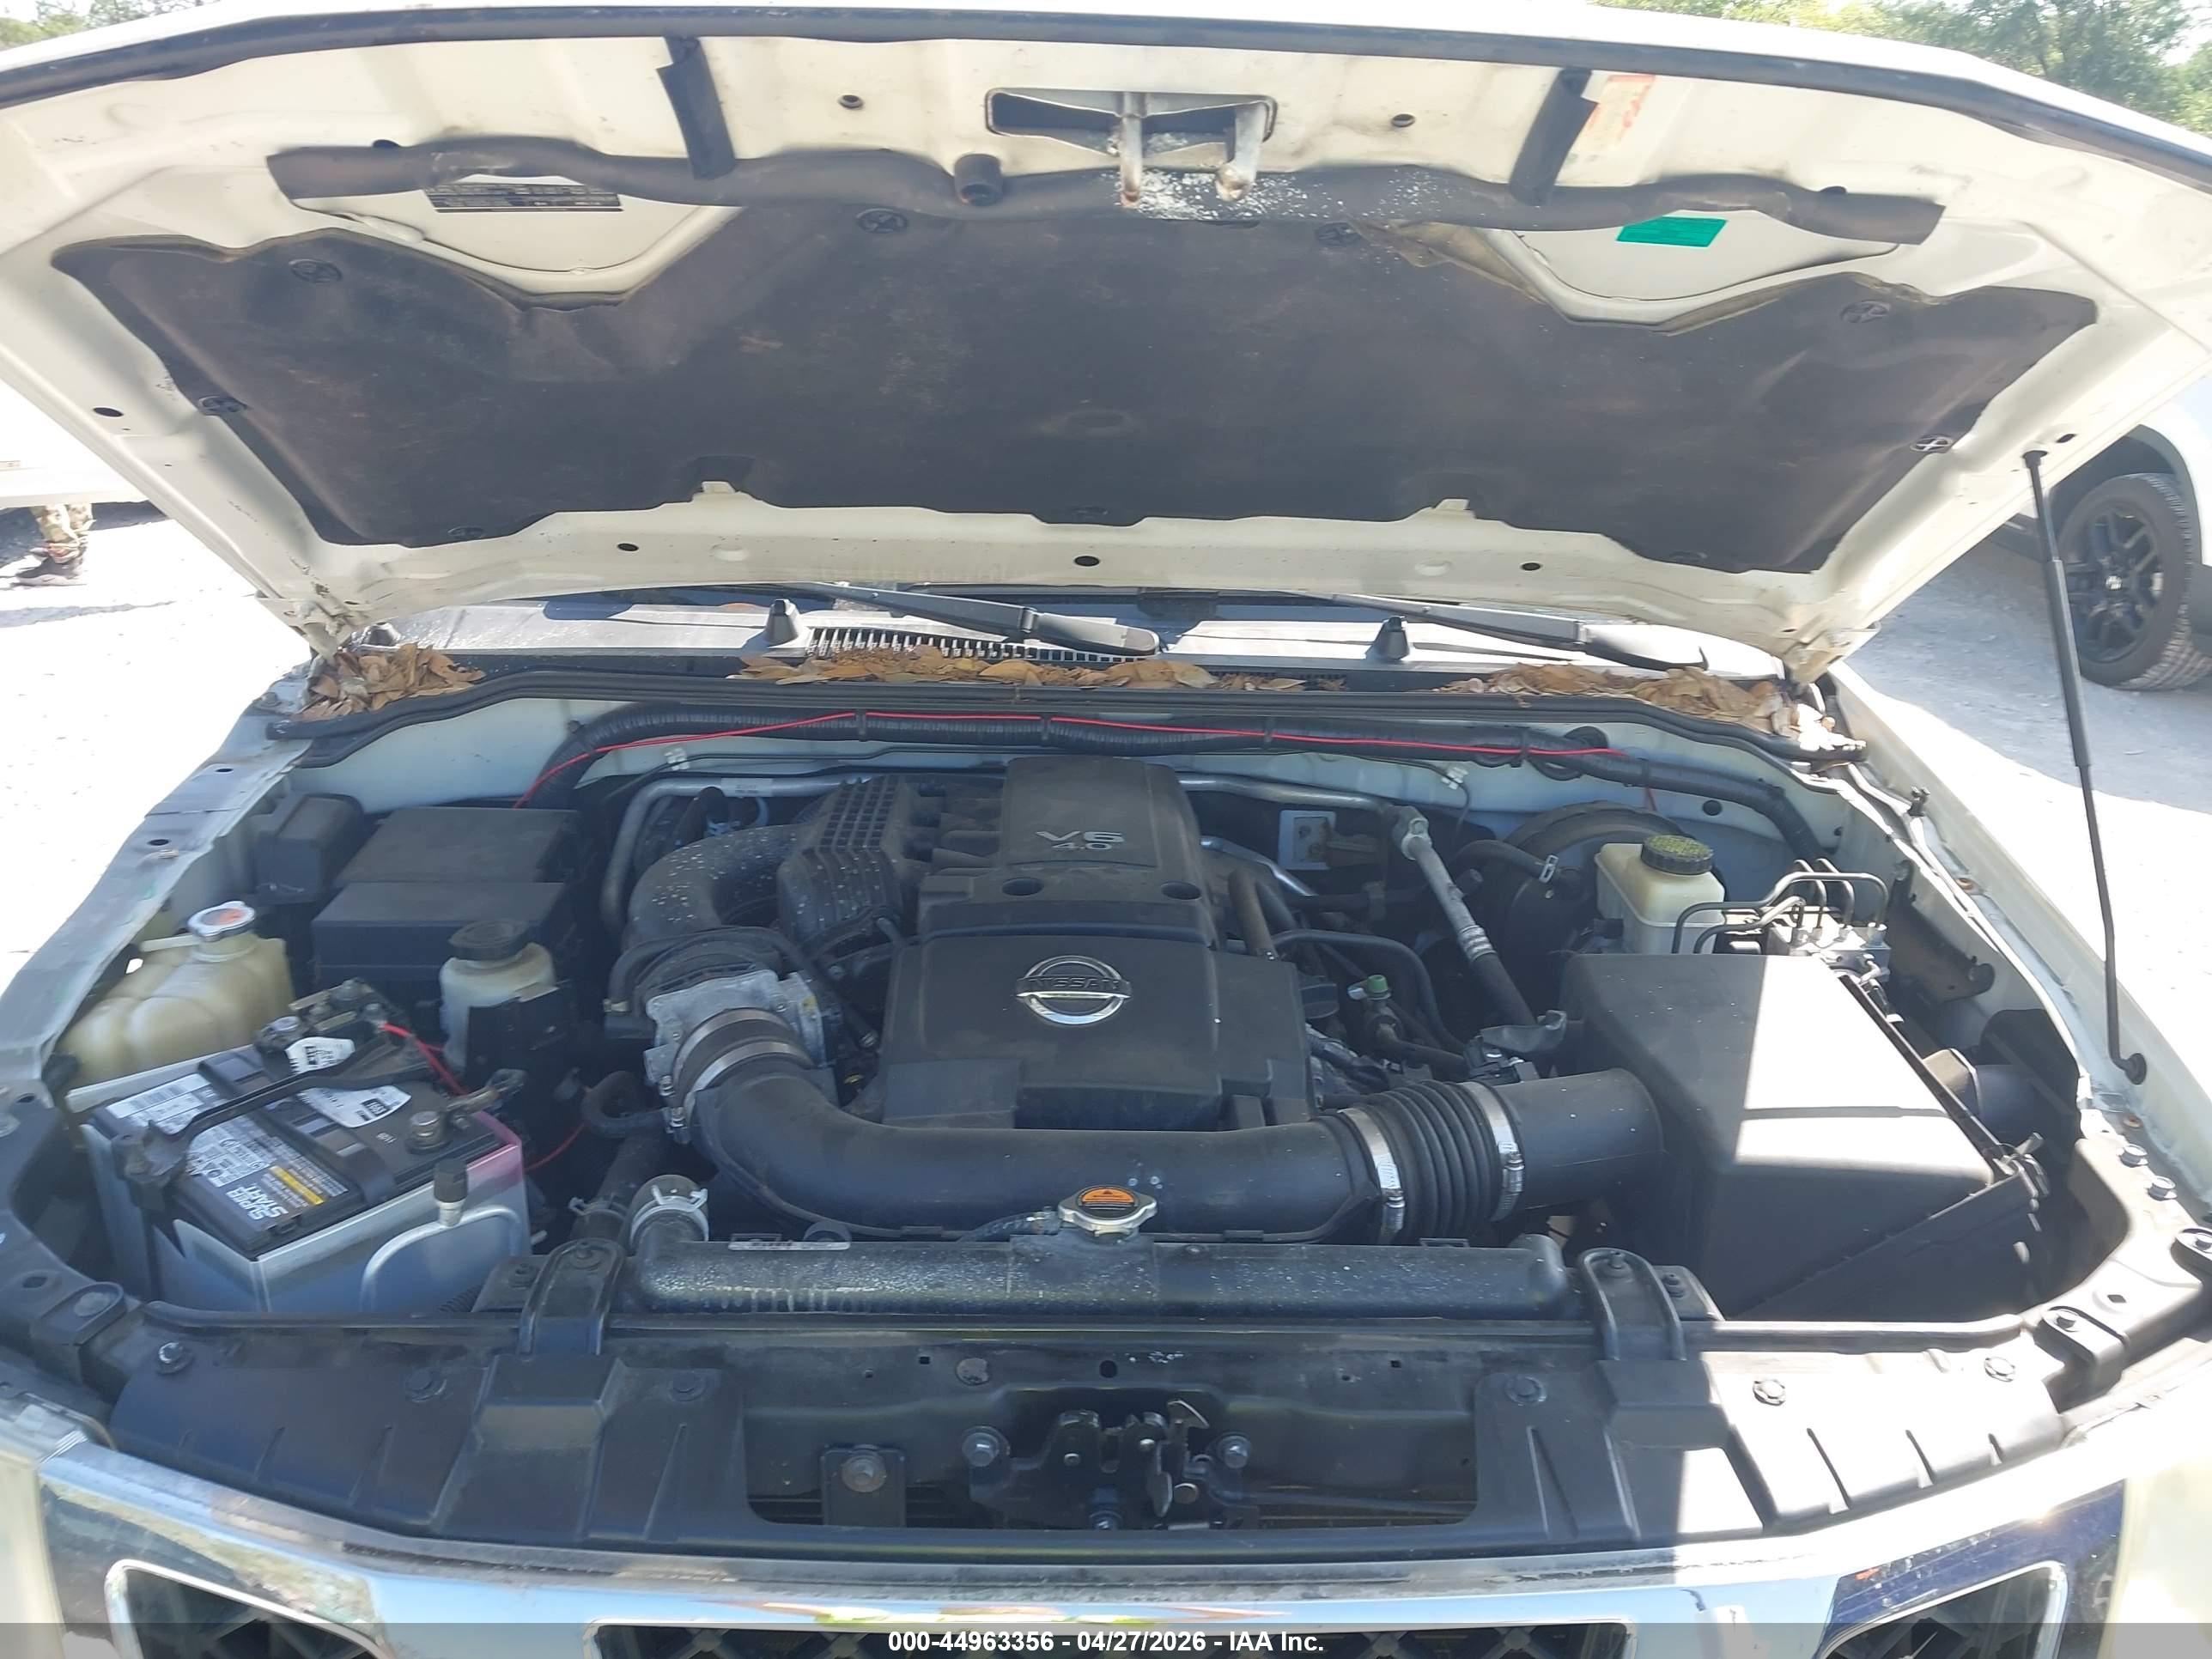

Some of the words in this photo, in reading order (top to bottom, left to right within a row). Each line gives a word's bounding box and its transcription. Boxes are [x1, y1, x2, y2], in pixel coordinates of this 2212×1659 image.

[1036, 830, 1125, 843] V6
[1028, 977, 1119, 989] NISSAN
[225, 1186, 265, 1220] SUPER
[243, 1185, 289, 1218] START
